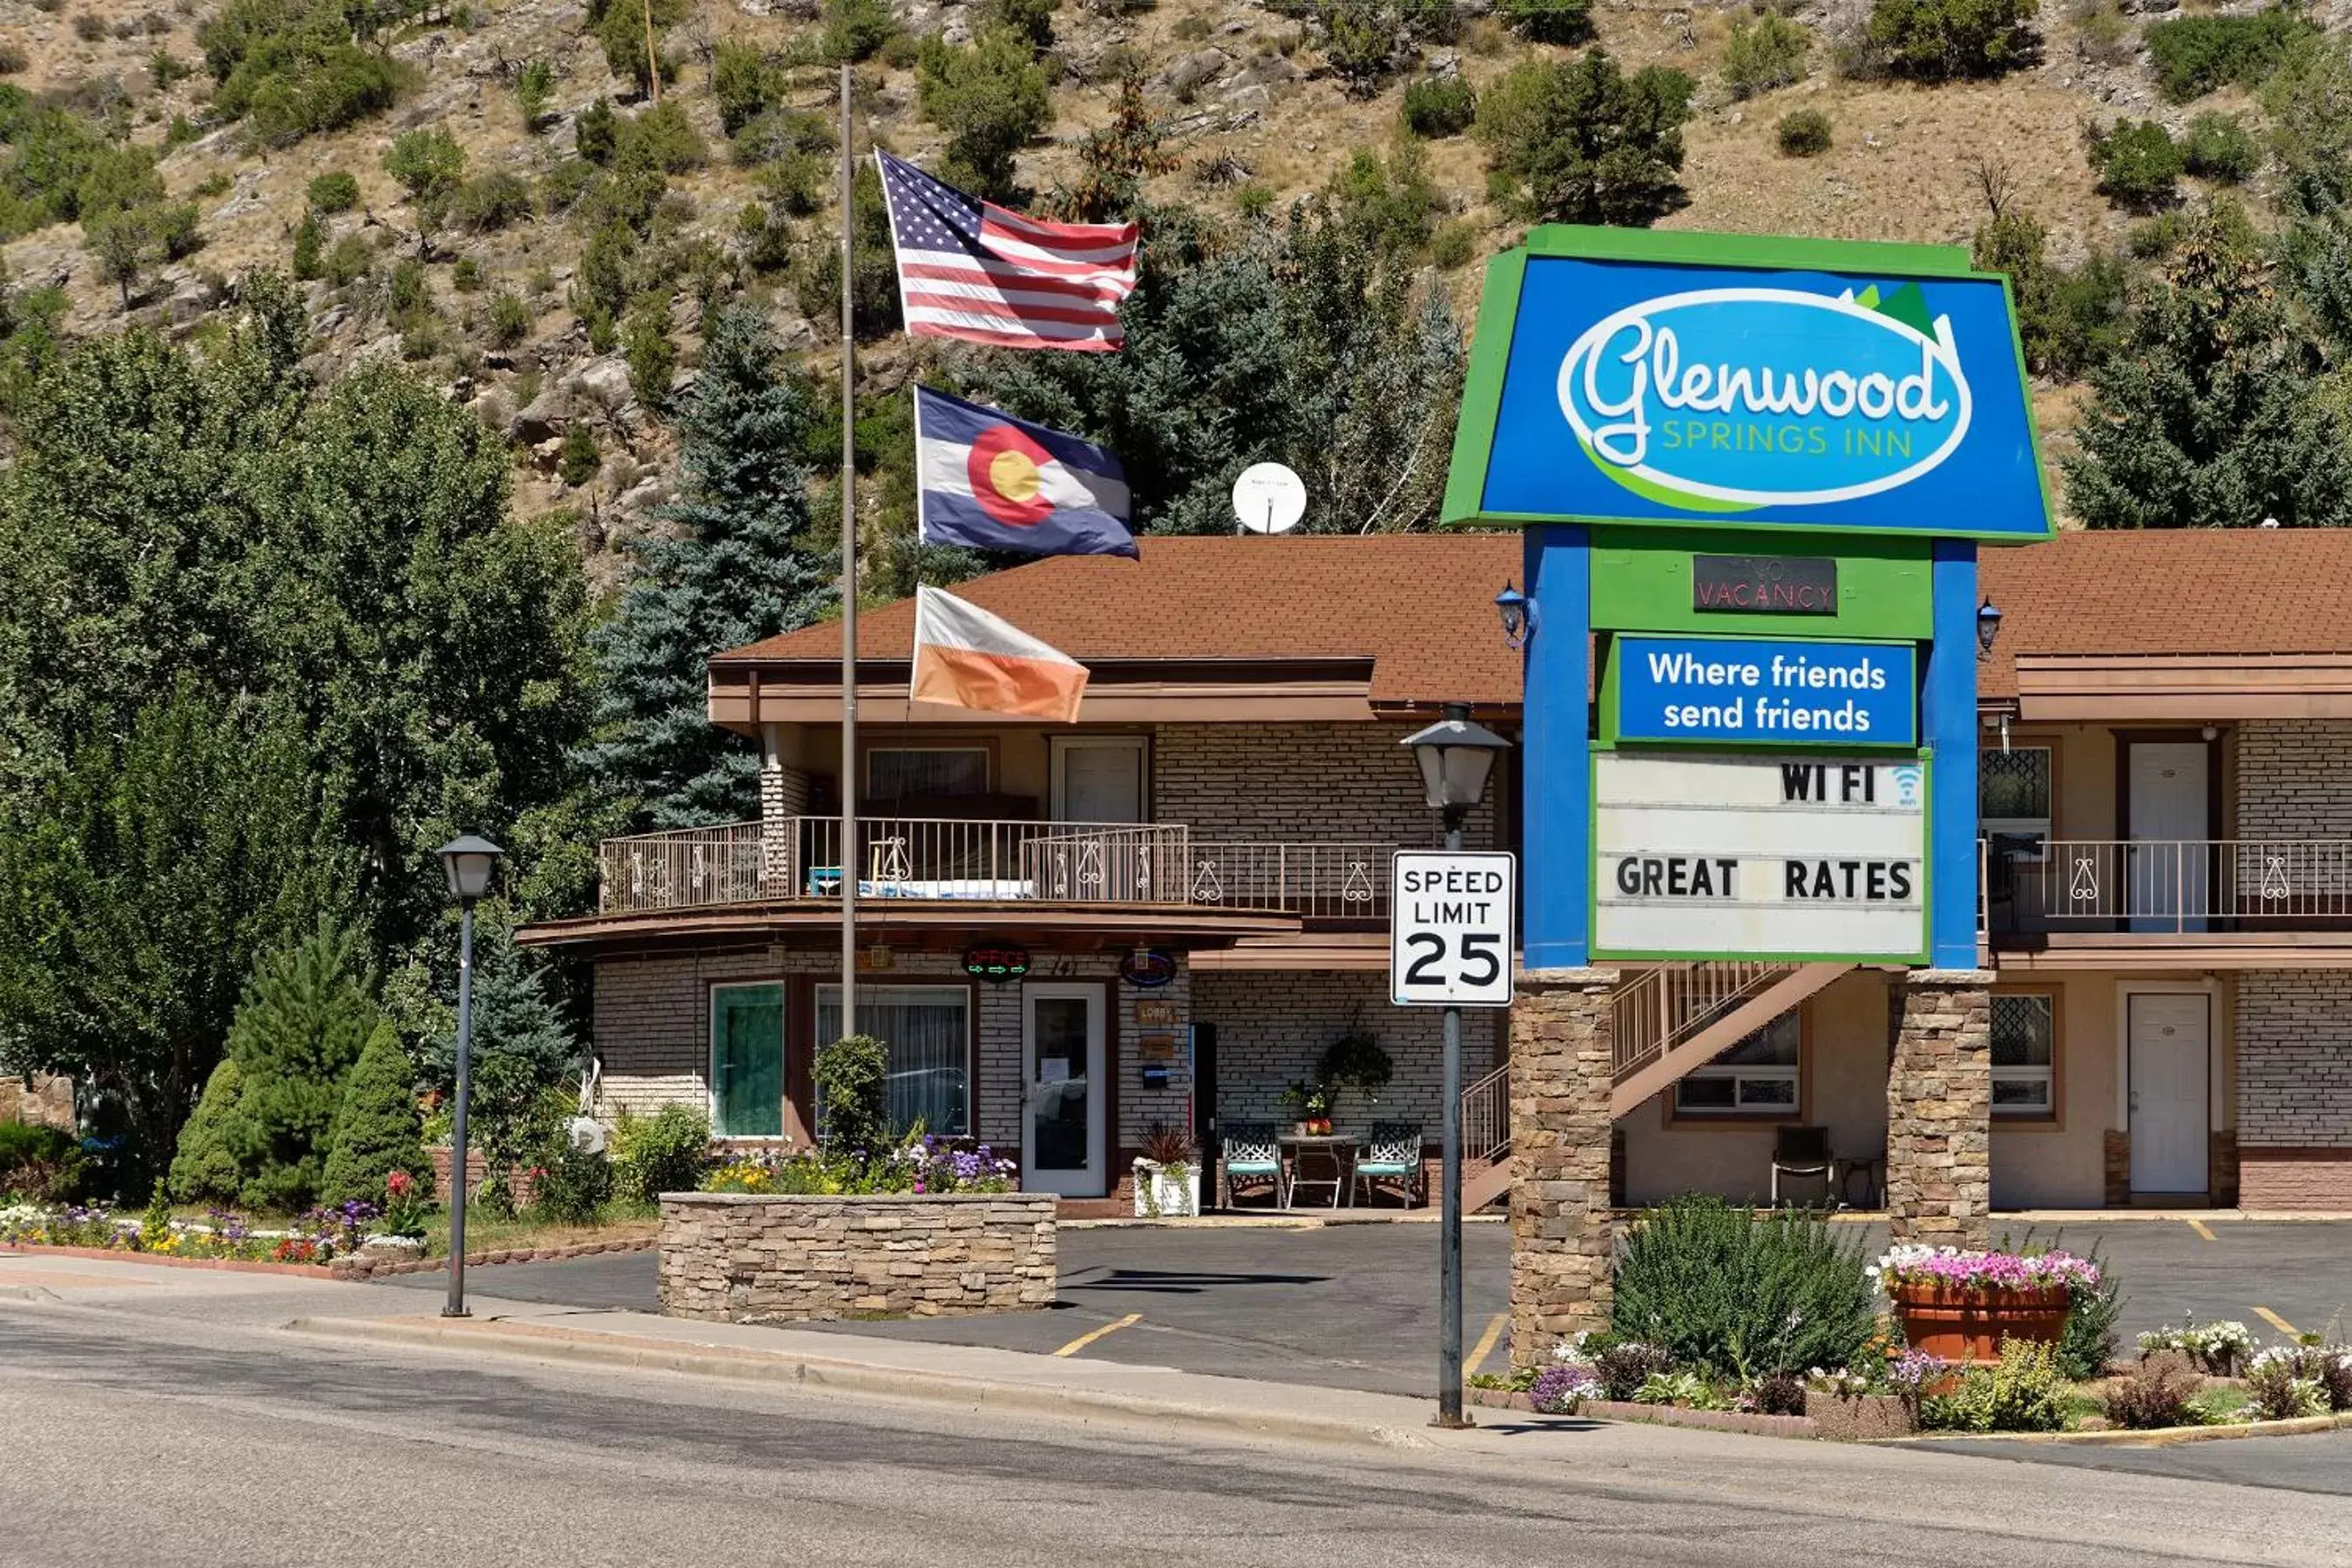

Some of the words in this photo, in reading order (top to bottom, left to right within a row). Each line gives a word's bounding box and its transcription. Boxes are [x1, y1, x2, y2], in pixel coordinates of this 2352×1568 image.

[1585, 314, 1949, 466] Glenwood
[1662, 420, 1828, 455] SPRINGS
[1844, 426, 1913, 457] INN
[1698, 581, 1832, 610] VACANCY
[1648, 652, 1761, 686] Where
[1771, 655, 1887, 689] friends
[1663, 697, 1744, 729] send
[1755, 697, 1870, 731] friends
[1404, 871, 1504, 893] SPEED
[1617, 856, 1739, 897] GREAT
[1785, 860, 1911, 899] RATES
[1415, 902, 1490, 924] LIMIT
[968, 950, 1026, 966] OFFICE
[1404, 932, 1501, 987] 25
[1141, 1007, 1173, 1018] LOBBY
